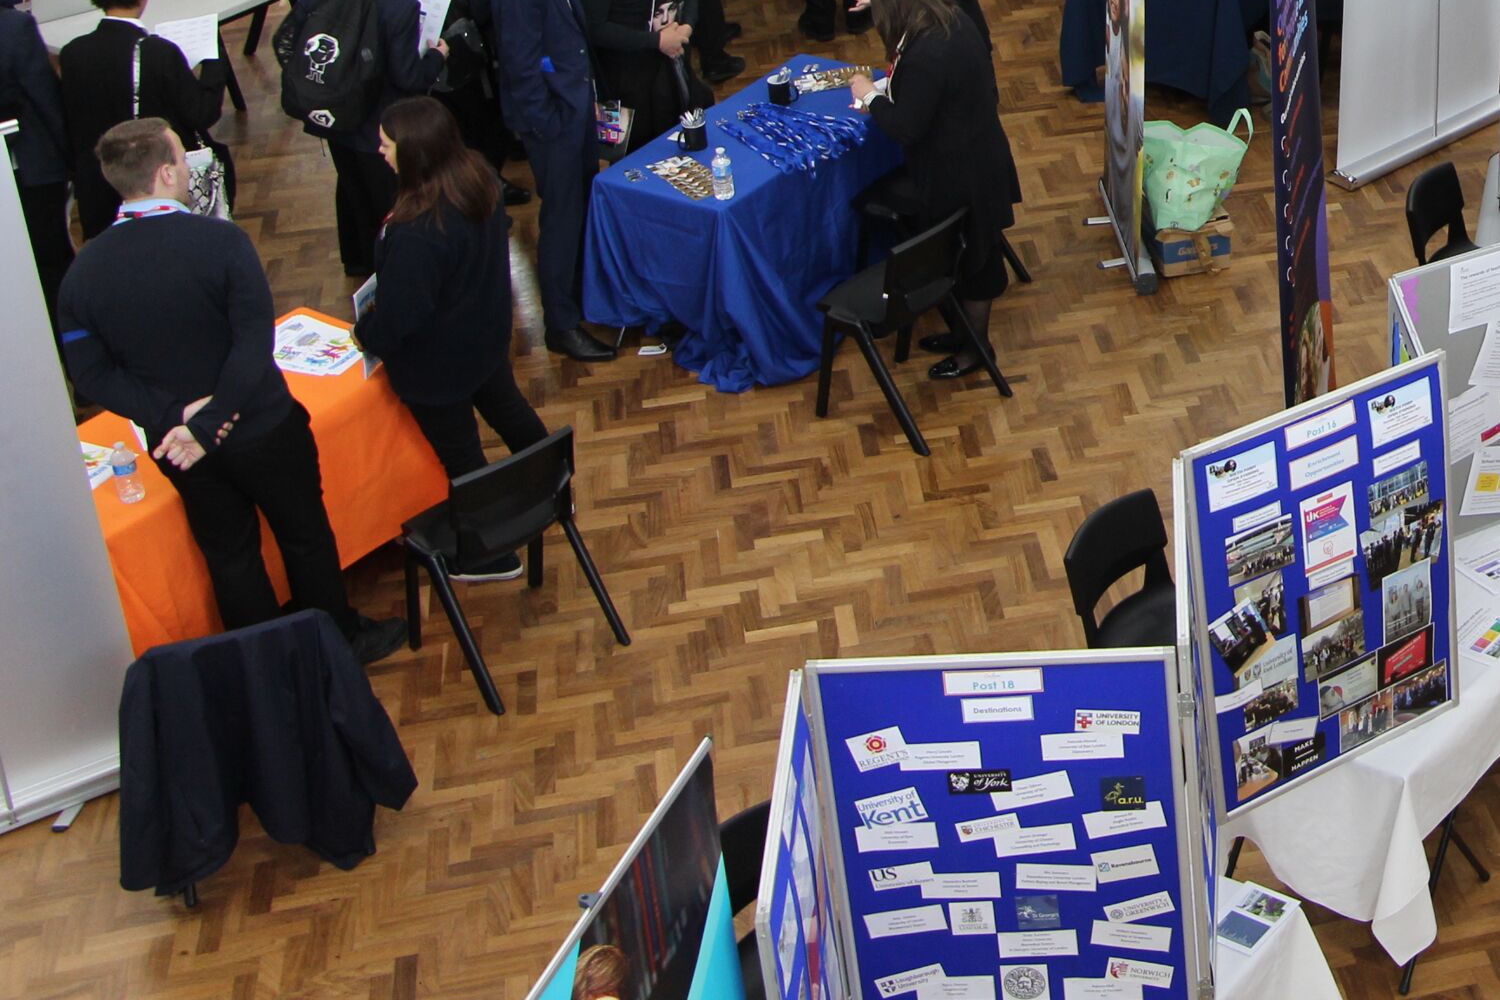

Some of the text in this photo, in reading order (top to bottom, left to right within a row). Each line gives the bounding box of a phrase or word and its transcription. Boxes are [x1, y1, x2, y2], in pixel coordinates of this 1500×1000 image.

[1306, 420, 1337, 438] Post 16
[1307, 451, 1341, 468] Enrichment
[1304, 459, 1345, 478] Opportunities
[1306, 511, 1320, 522] UK
[1262, 652, 1286, 667] University
[972, 680, 1015, 691] Post 18
[973, 706, 1022, 714] Destinations
[1096, 712, 1138, 720] UNIVERSITY
[1294, 739, 1314, 752] MAKE
[858, 749, 909, 768] REGENT'S
[1291, 754, 1319, 772] HAPPEN
[976, 778, 1010, 790] York
[857, 790, 916, 812] University of
[1118, 795, 1144, 804] a.r.u.
[860, 800, 926, 830] Kent
[1110, 858, 1152, 868] Ravensbourne
[871, 868, 898, 882] US
[1122, 898, 1163, 912] UNIVERSITY
[1124, 901, 1170, 918] GREENWICH
[894, 968, 940, 984] Loughborough
[1130, 968, 1171, 979] NORWICH
[898, 978, 928, 989] University
